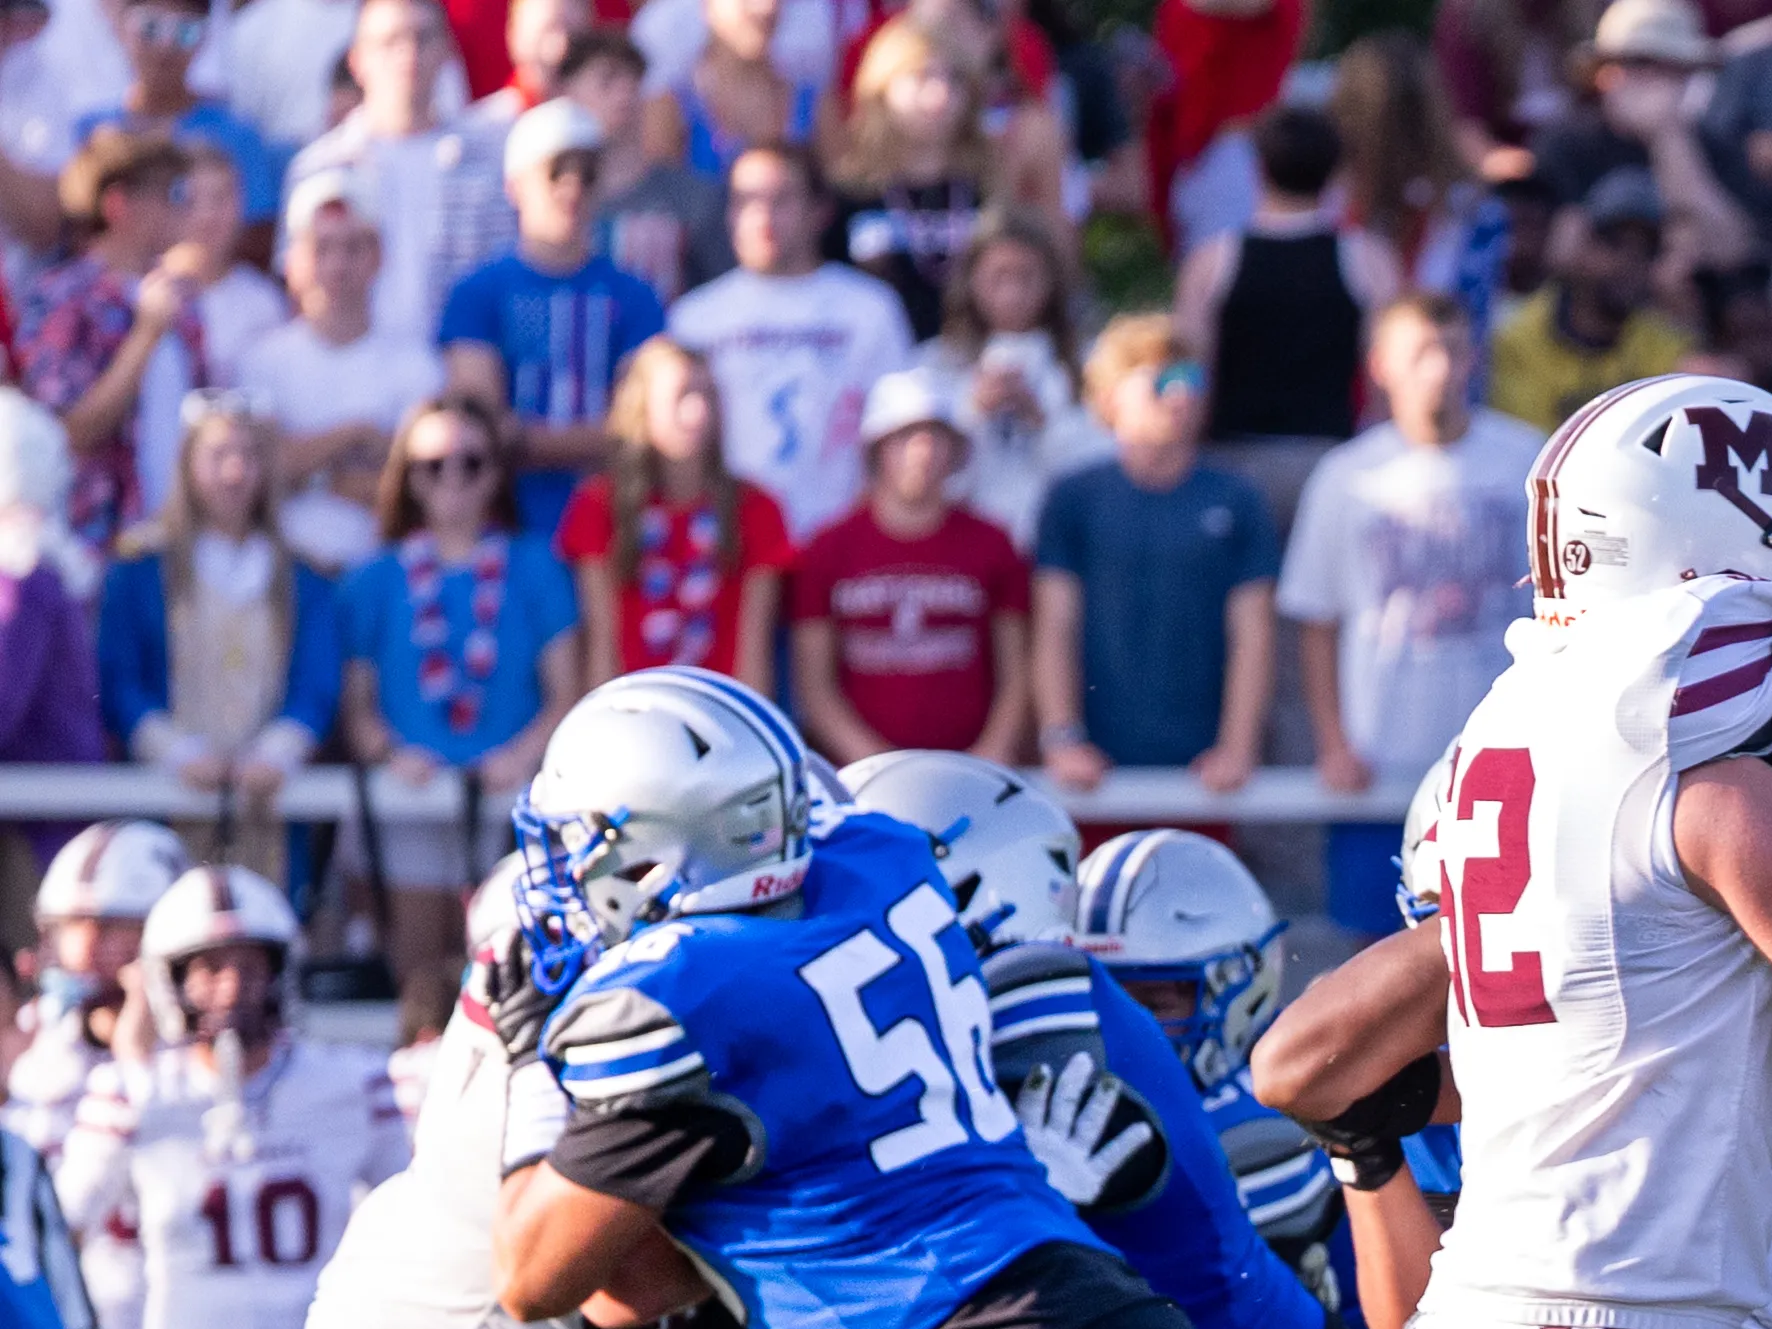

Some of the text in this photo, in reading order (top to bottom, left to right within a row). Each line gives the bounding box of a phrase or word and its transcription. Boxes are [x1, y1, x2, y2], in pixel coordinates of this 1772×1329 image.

[1565, 544, 1588, 572] 52
[800, 882, 1018, 1173] 56
[203, 1179, 319, 1267] 10
